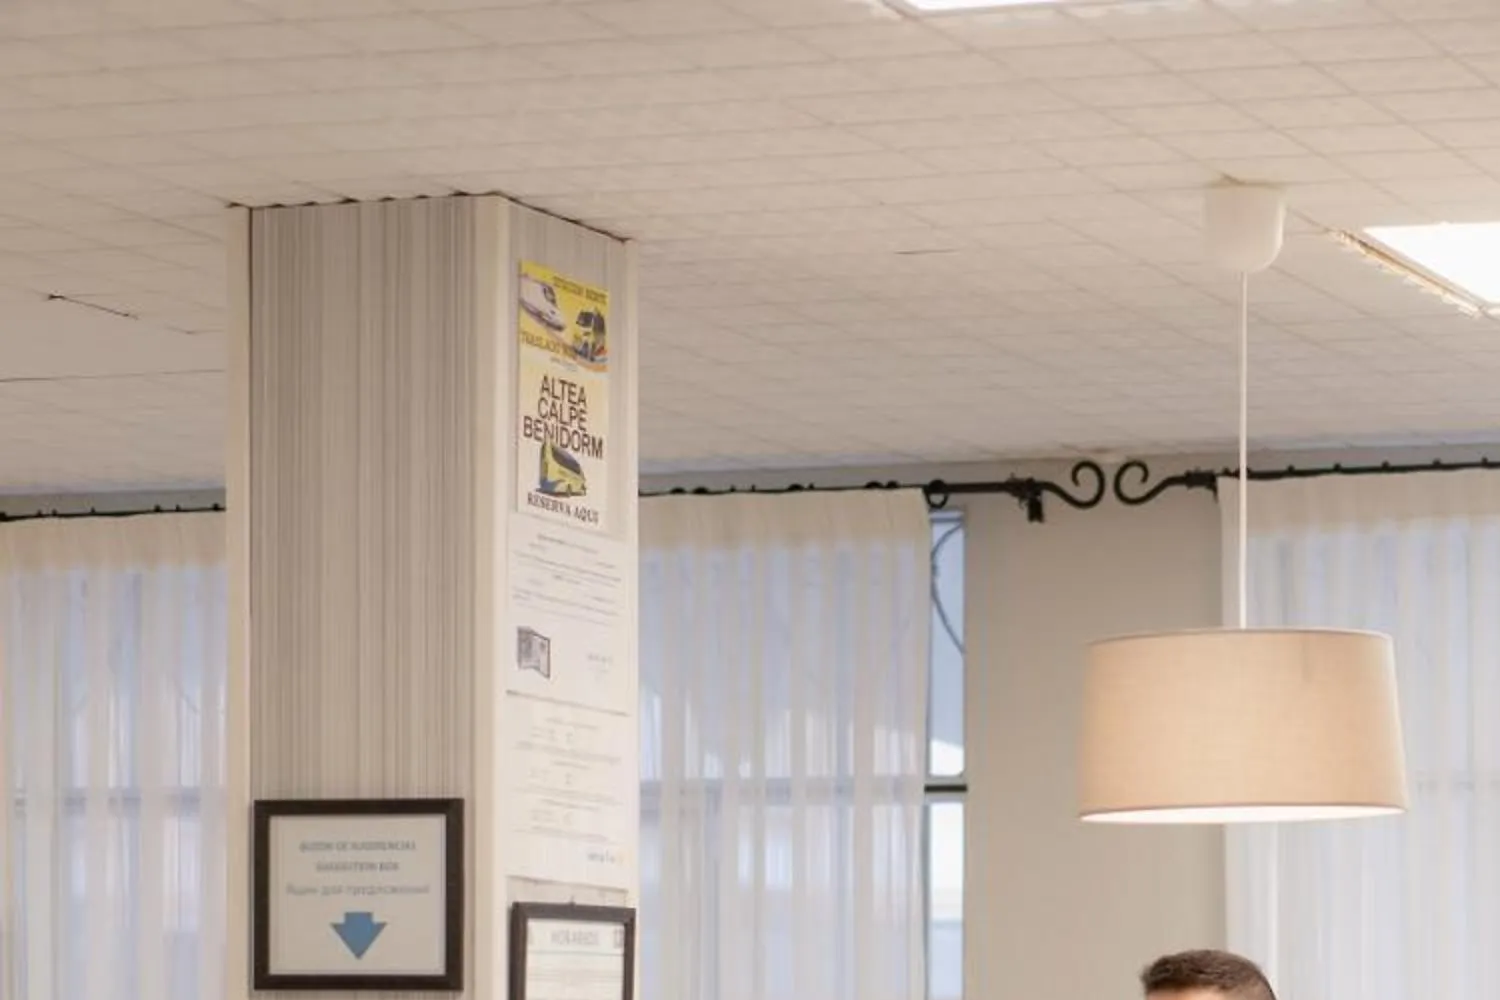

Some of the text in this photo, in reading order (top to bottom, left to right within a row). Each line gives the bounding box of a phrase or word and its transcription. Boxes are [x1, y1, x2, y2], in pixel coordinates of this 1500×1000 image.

[541, 375, 587, 408] ALTEA
[538, 397, 586, 432] CALPE
[523, 415, 603, 459] BENIDORM
[527, 492, 571, 517] RESERVA
